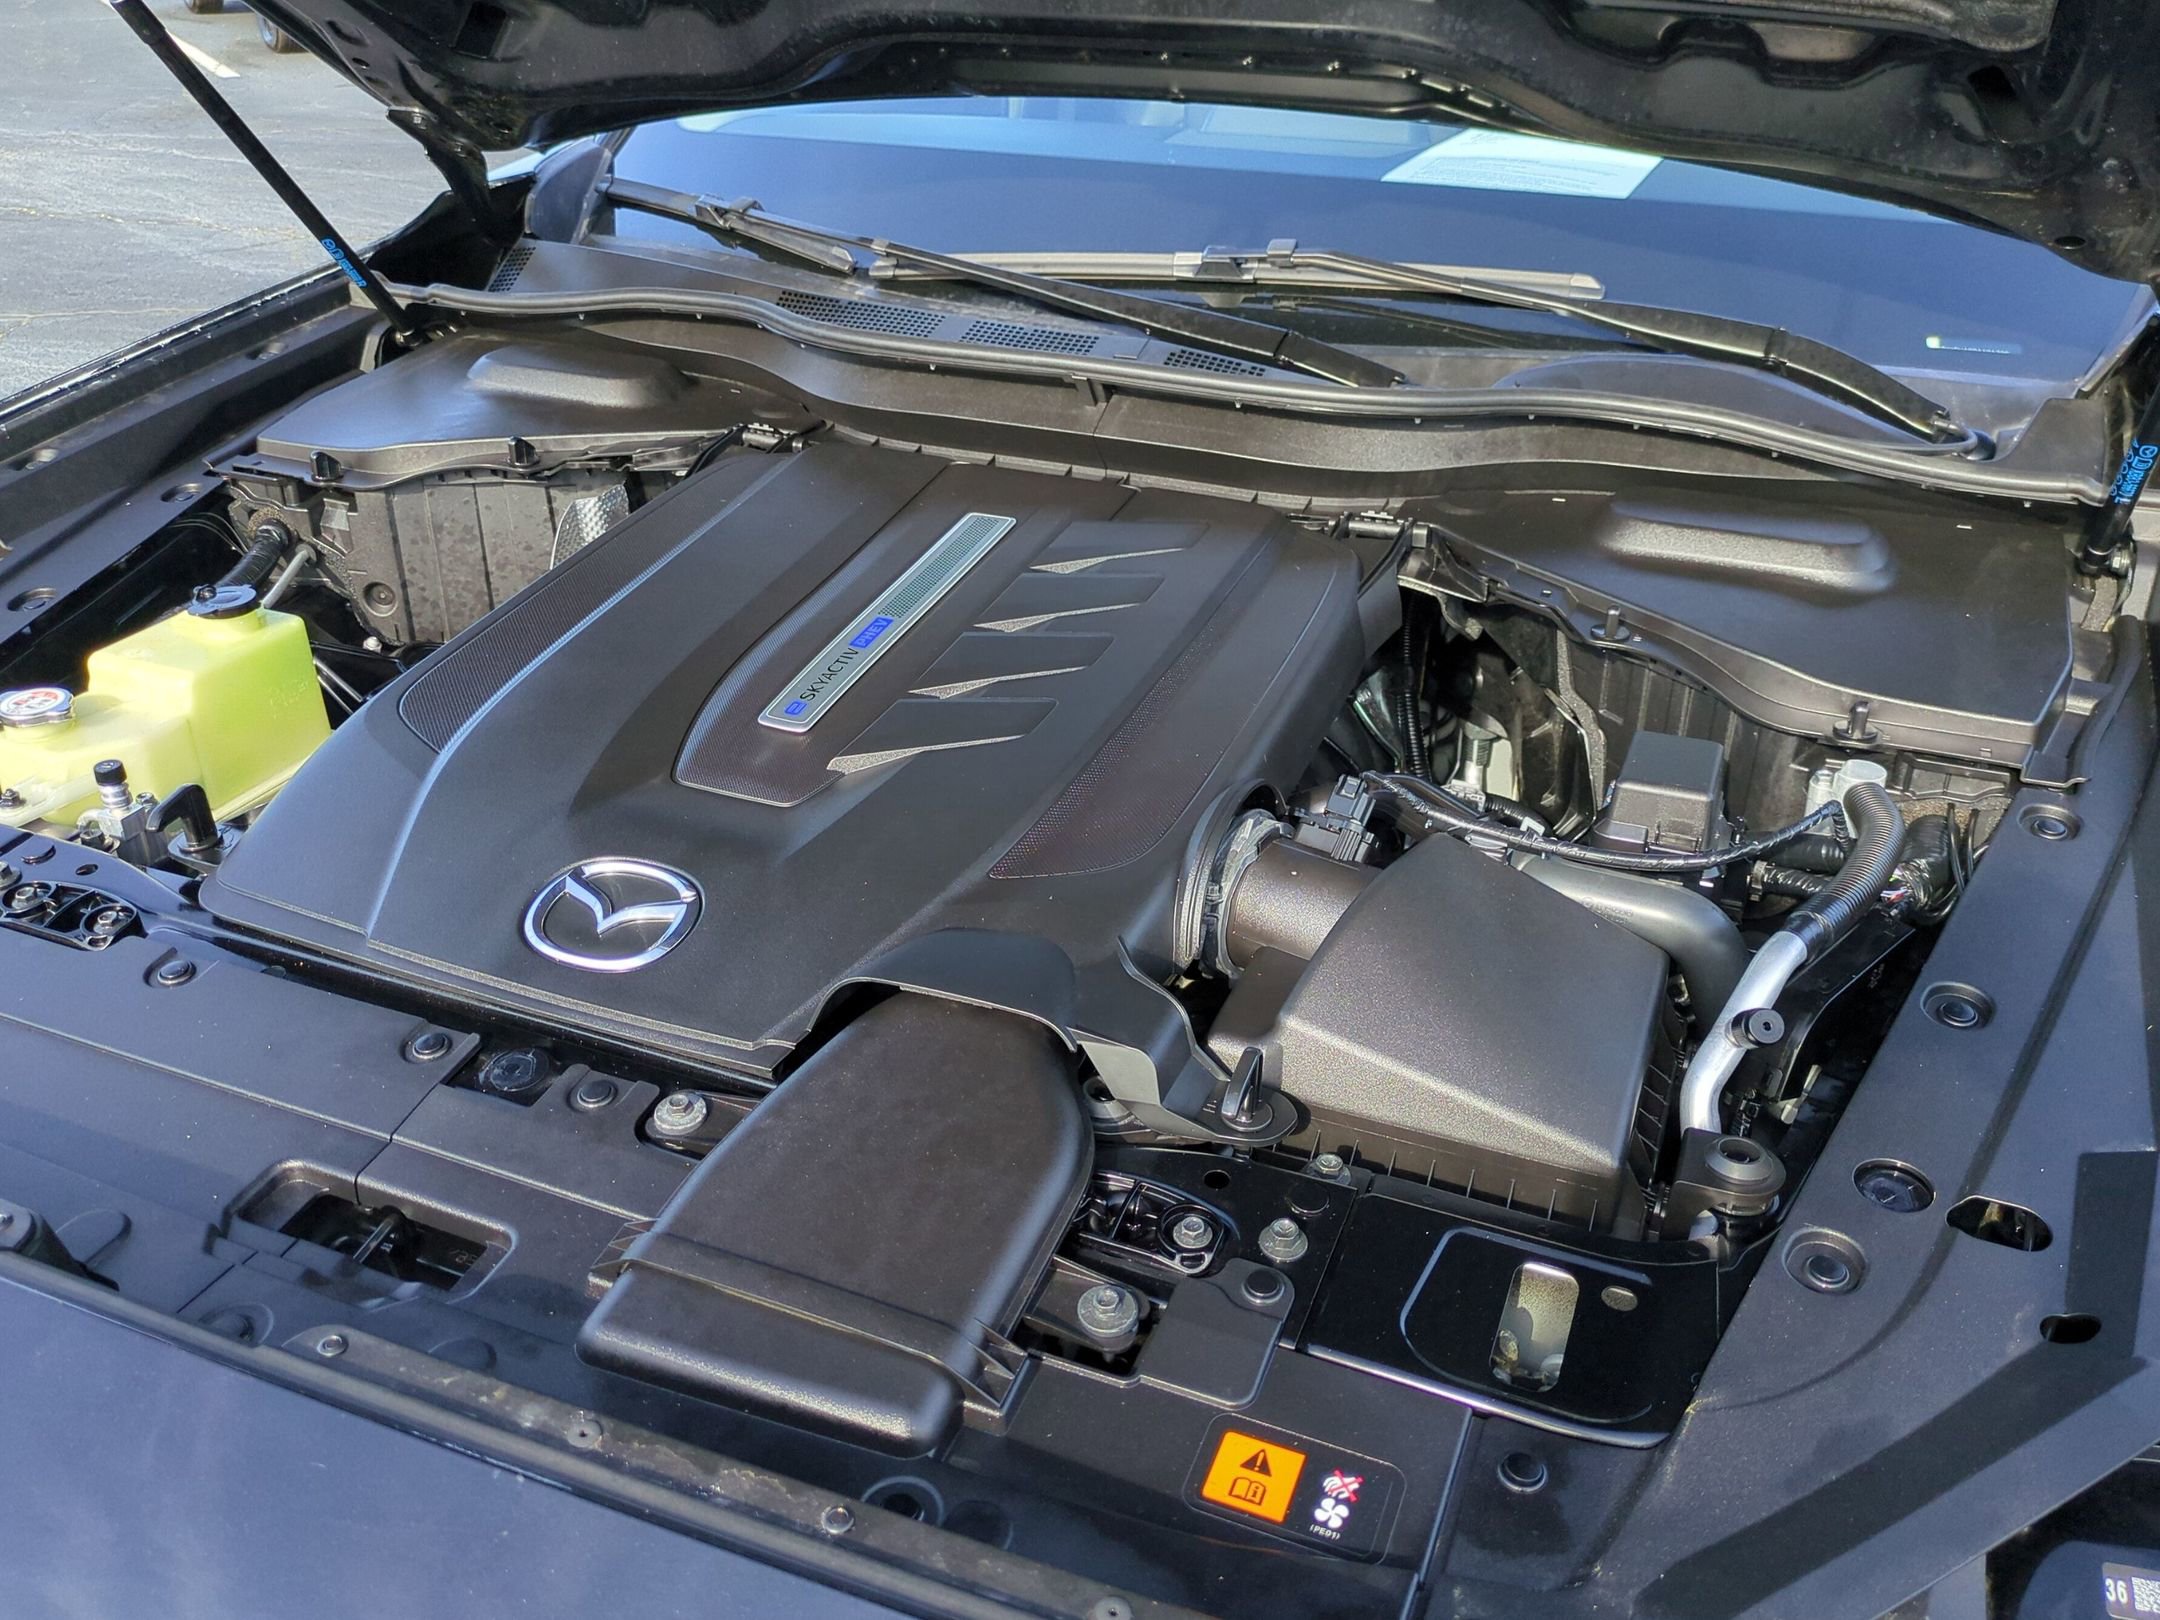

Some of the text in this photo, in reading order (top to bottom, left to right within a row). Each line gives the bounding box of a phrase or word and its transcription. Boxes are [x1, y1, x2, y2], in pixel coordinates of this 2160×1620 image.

[800, 647, 859, 701] SKYACTIV
[853, 618, 890, 647] PHEV
[2105, 1578, 2128, 1604] 36
